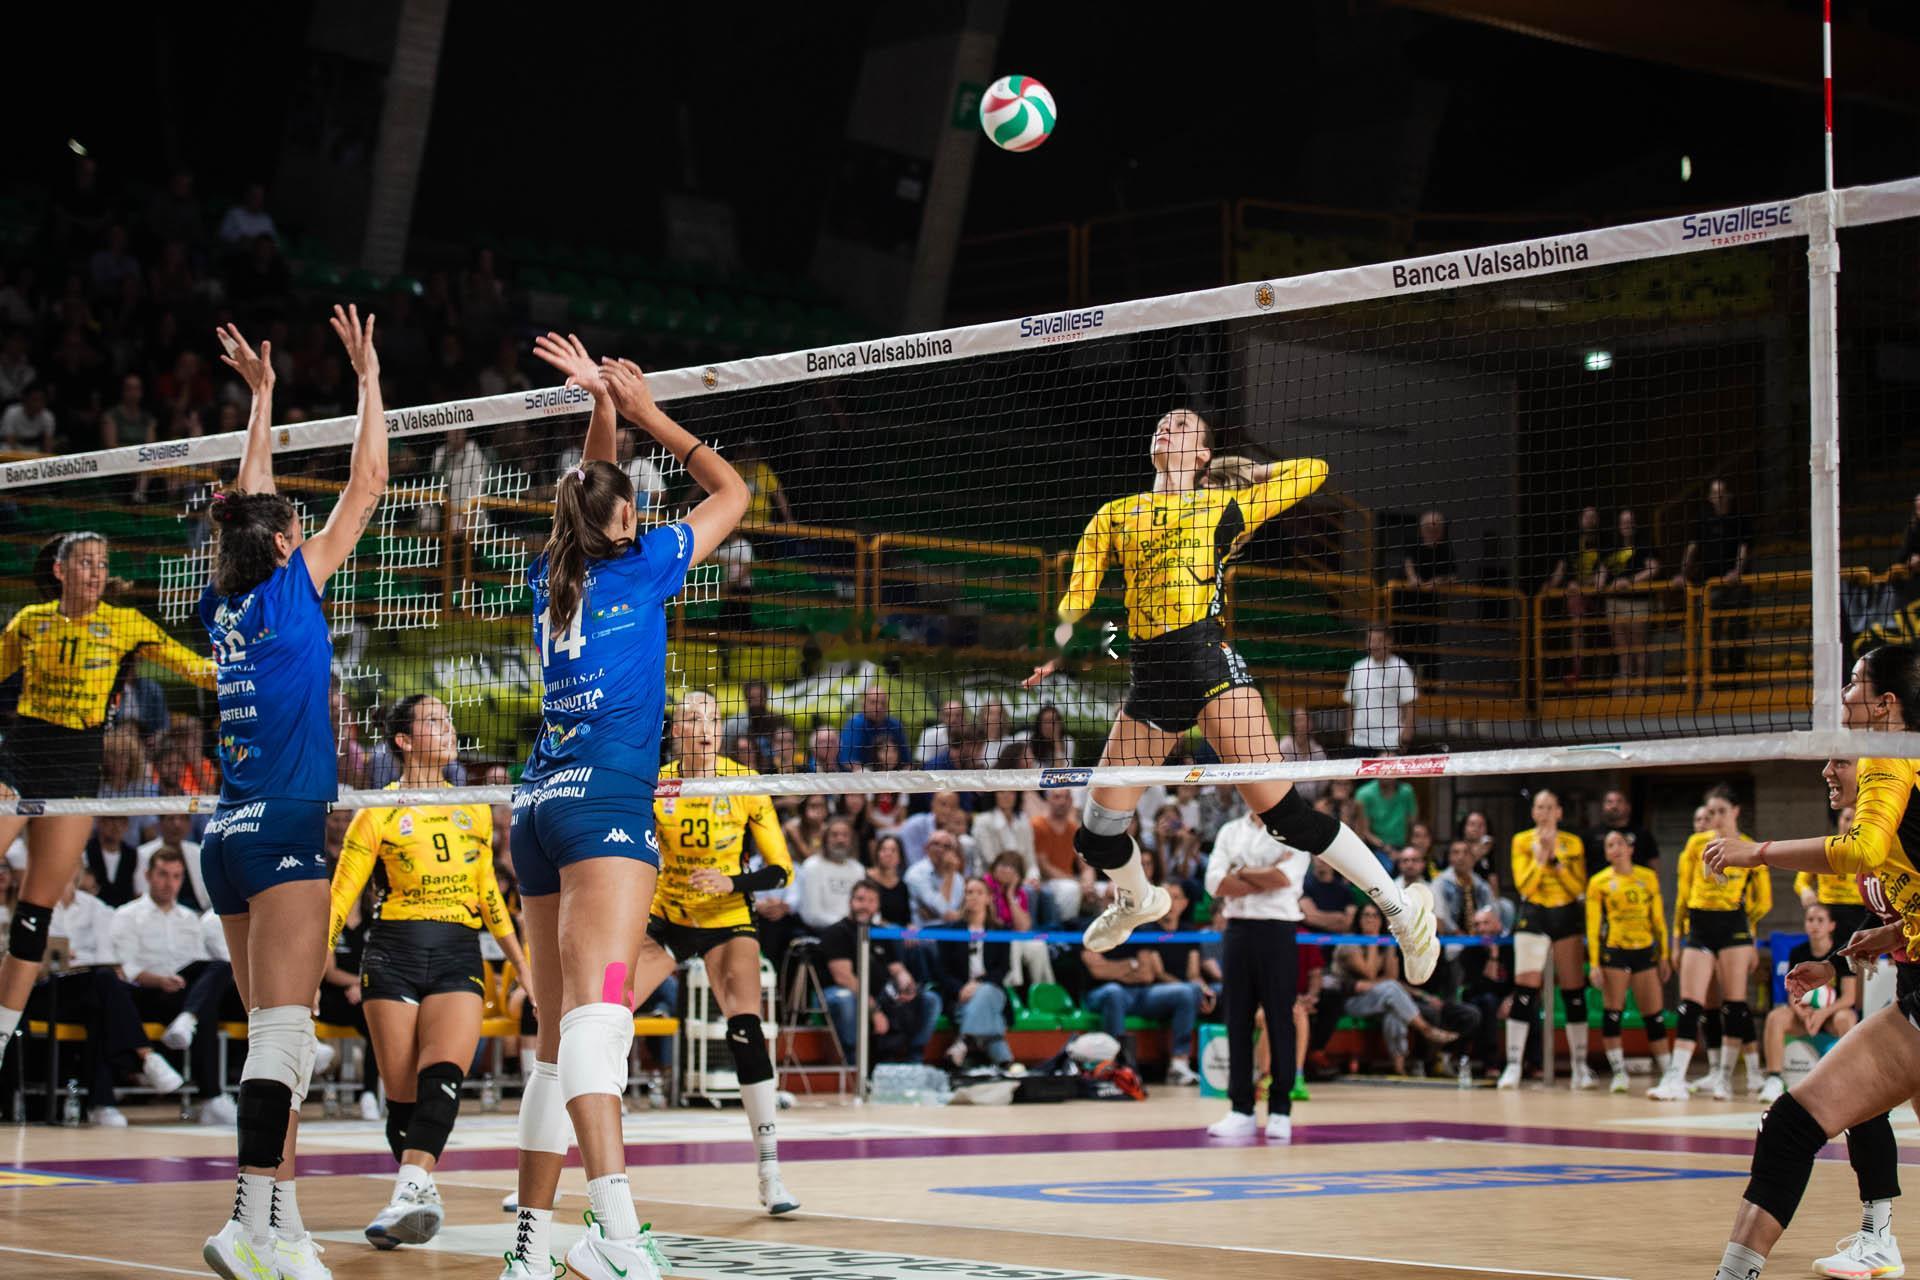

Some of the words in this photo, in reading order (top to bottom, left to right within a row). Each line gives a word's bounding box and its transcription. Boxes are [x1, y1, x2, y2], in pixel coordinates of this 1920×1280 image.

[1682, 206, 1792, 241] Savallese
[1711, 232, 1768, 246] TRASPORTI
[1392, 262, 1460, 288] Banca
[1464, 241, 1588, 277] Valsabbina
[1020, 310, 1104, 338] Savallese
[807, 351, 856, 372] Banca
[859, 337, 953, 365] Valsabbina
[525, 387, 589, 410] Savallese
[401, 407, 474, 431] Valsabbina
[6, 467, 38, 483] Banca
[40, 457, 98, 479] Valsabbina
[538, 598, 587, 668] 14
[59, 635, 78, 665] 11
[579, 668, 605, 683] S.r.l.
[432, 832, 450, 863] 9
[680, 818, 710, 849] 23
[421, 874, 468, 886] Banca
